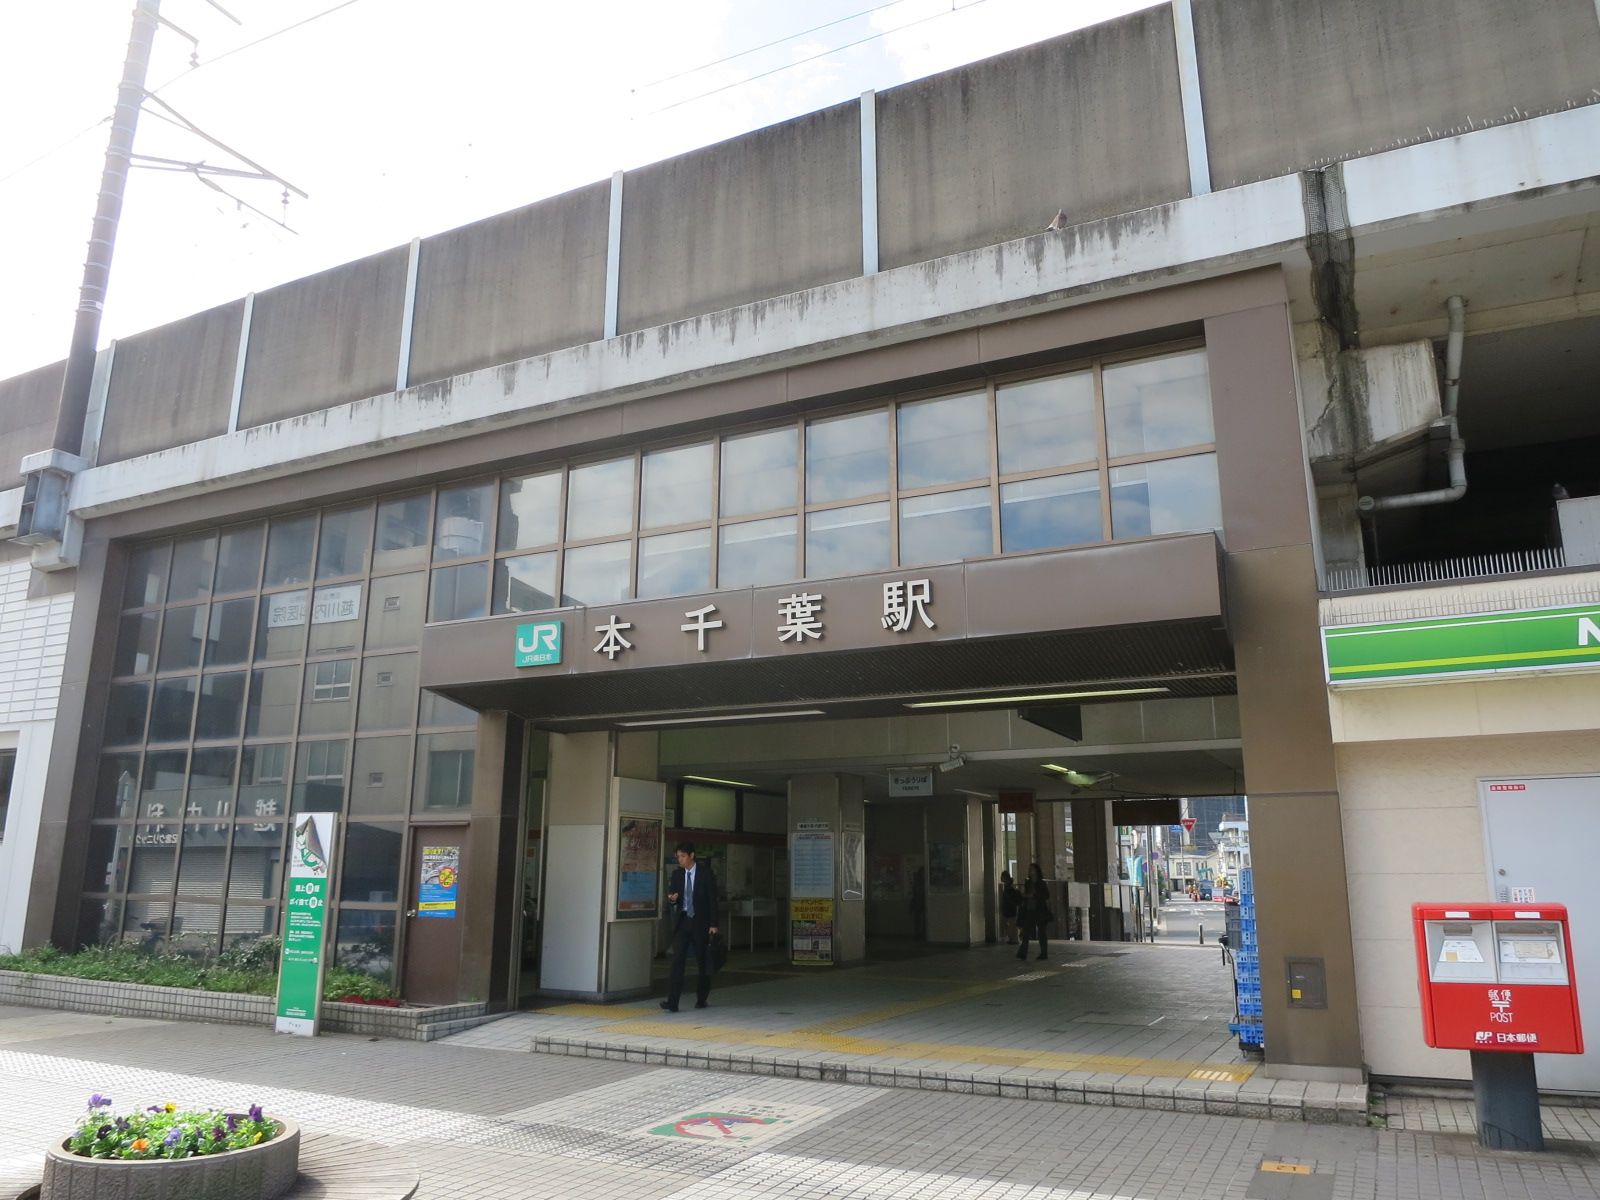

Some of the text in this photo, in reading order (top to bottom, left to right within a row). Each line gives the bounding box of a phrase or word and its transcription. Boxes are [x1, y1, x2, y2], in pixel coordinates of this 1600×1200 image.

[593, 579, 935, 660] 本千葉駅
[518, 623, 558, 653] JR
[522, 653, 553, 663] JR東日本
[1488, 989, 1512, 1002] 郵便
[1490, 1012, 1513, 1023] POST
[1497, 1033, 1537, 1043] 日本郵便
